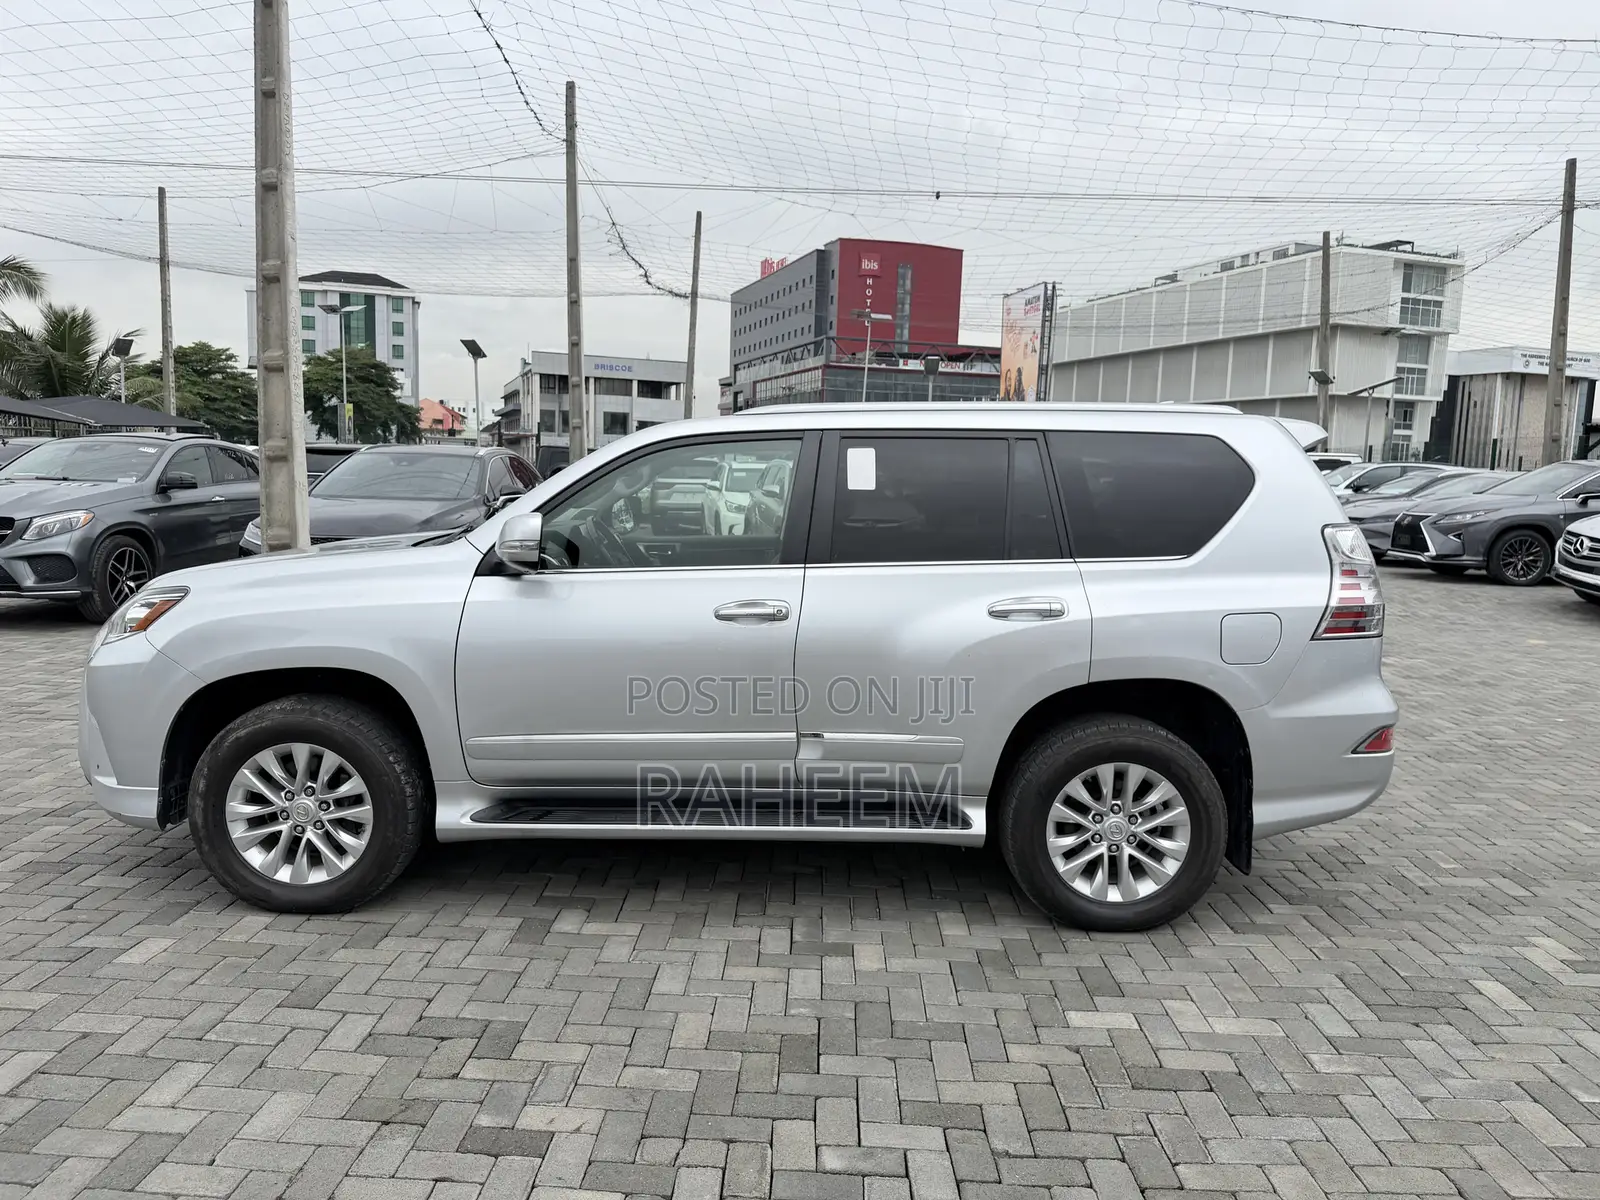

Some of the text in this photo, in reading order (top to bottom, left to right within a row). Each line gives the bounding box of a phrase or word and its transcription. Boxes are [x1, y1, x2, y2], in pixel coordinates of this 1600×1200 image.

[862, 259, 878, 270] ibis
[594, 363, 633, 372] BRISCOE
[940, 361, 960, 370] OPEN
